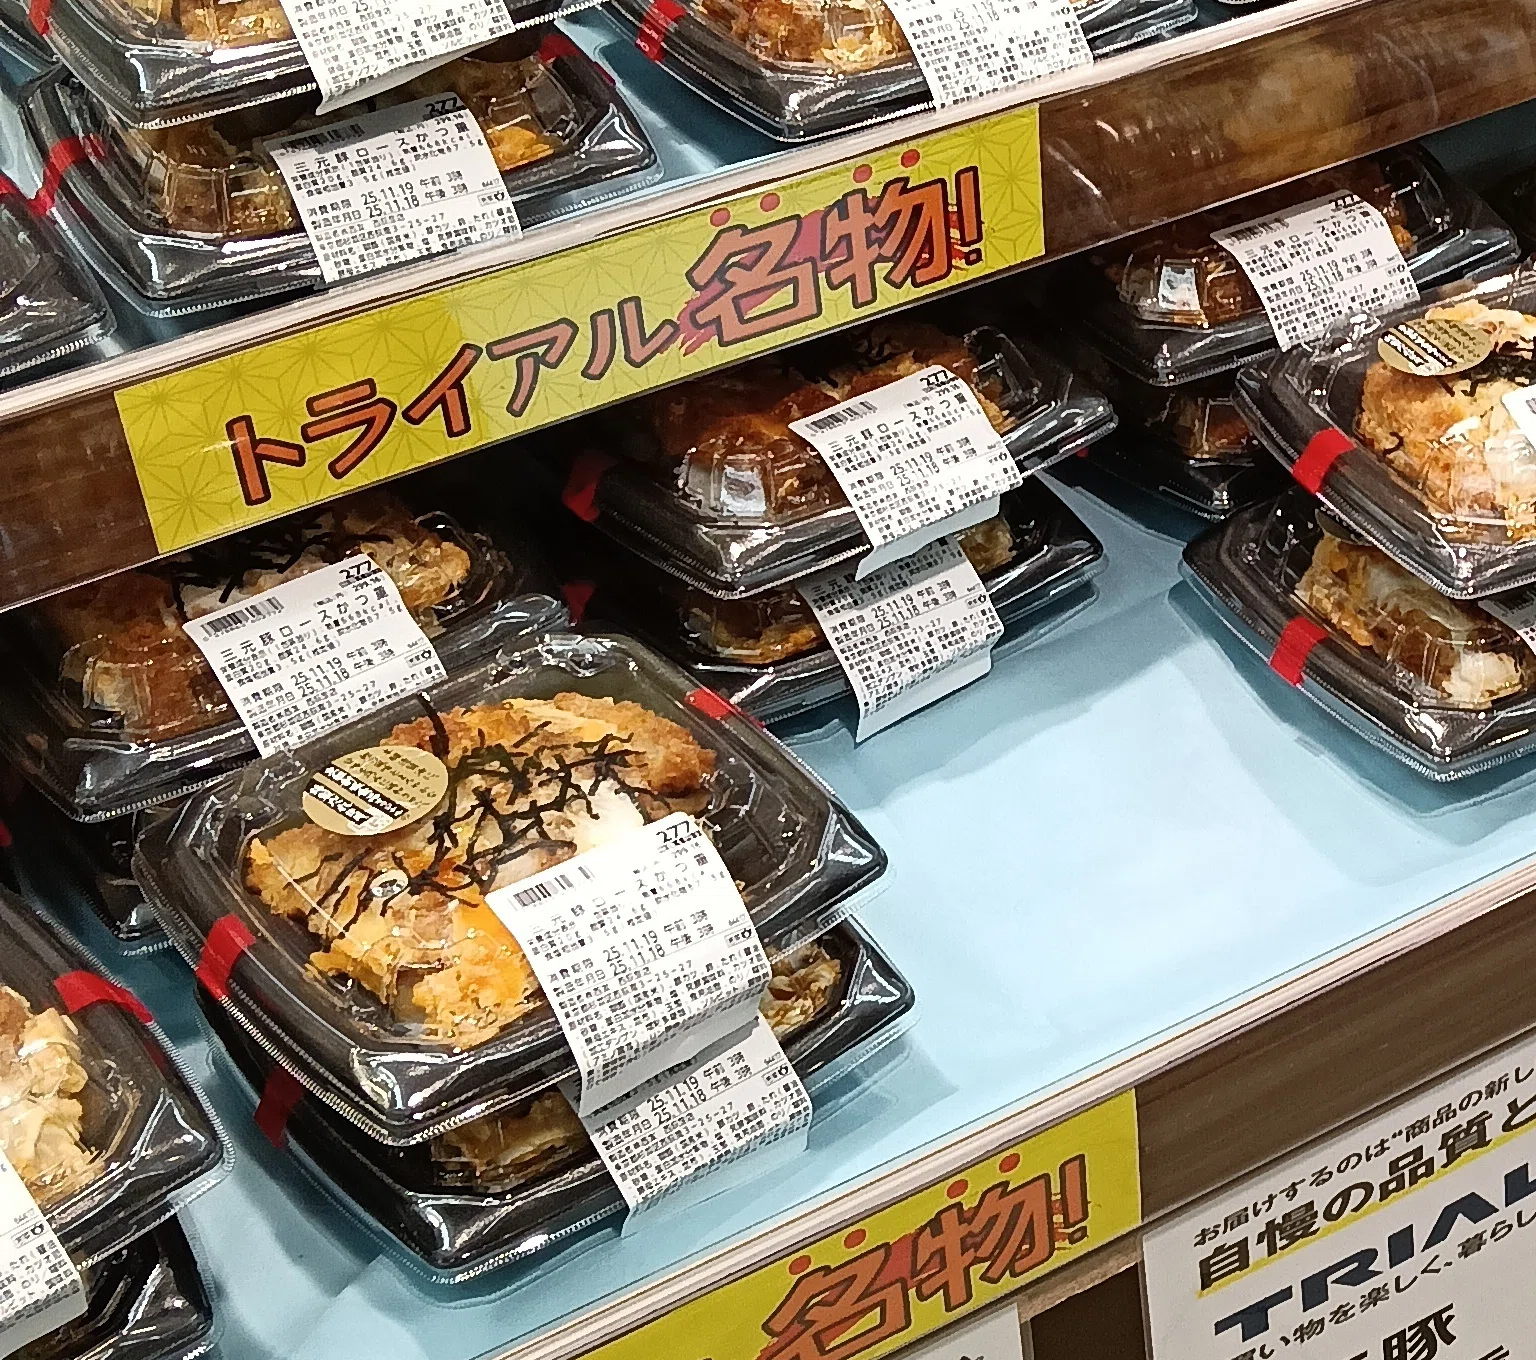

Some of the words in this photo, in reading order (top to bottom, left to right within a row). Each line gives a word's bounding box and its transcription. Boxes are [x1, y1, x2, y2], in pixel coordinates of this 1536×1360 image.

[425, 97, 459, 117] 277
[360, 181, 414, 207] 25.11.19
[366, 194, 420, 220] 25.11.18
[226, 164, 985, 507] トライアル名物!
[339, 559, 373, 581] 277
[290, 656, 343, 687] 25.11.19
[299, 667, 351, 698] 25.11.18
[655, 820, 691, 844] 277
[602, 929, 659, 963] 25.11.19
[610, 944, 666, 978] 25.11.18
[646, 1075, 700, 1113] 25.11.19
[656, 1089, 707, 1128] 25.11.18
